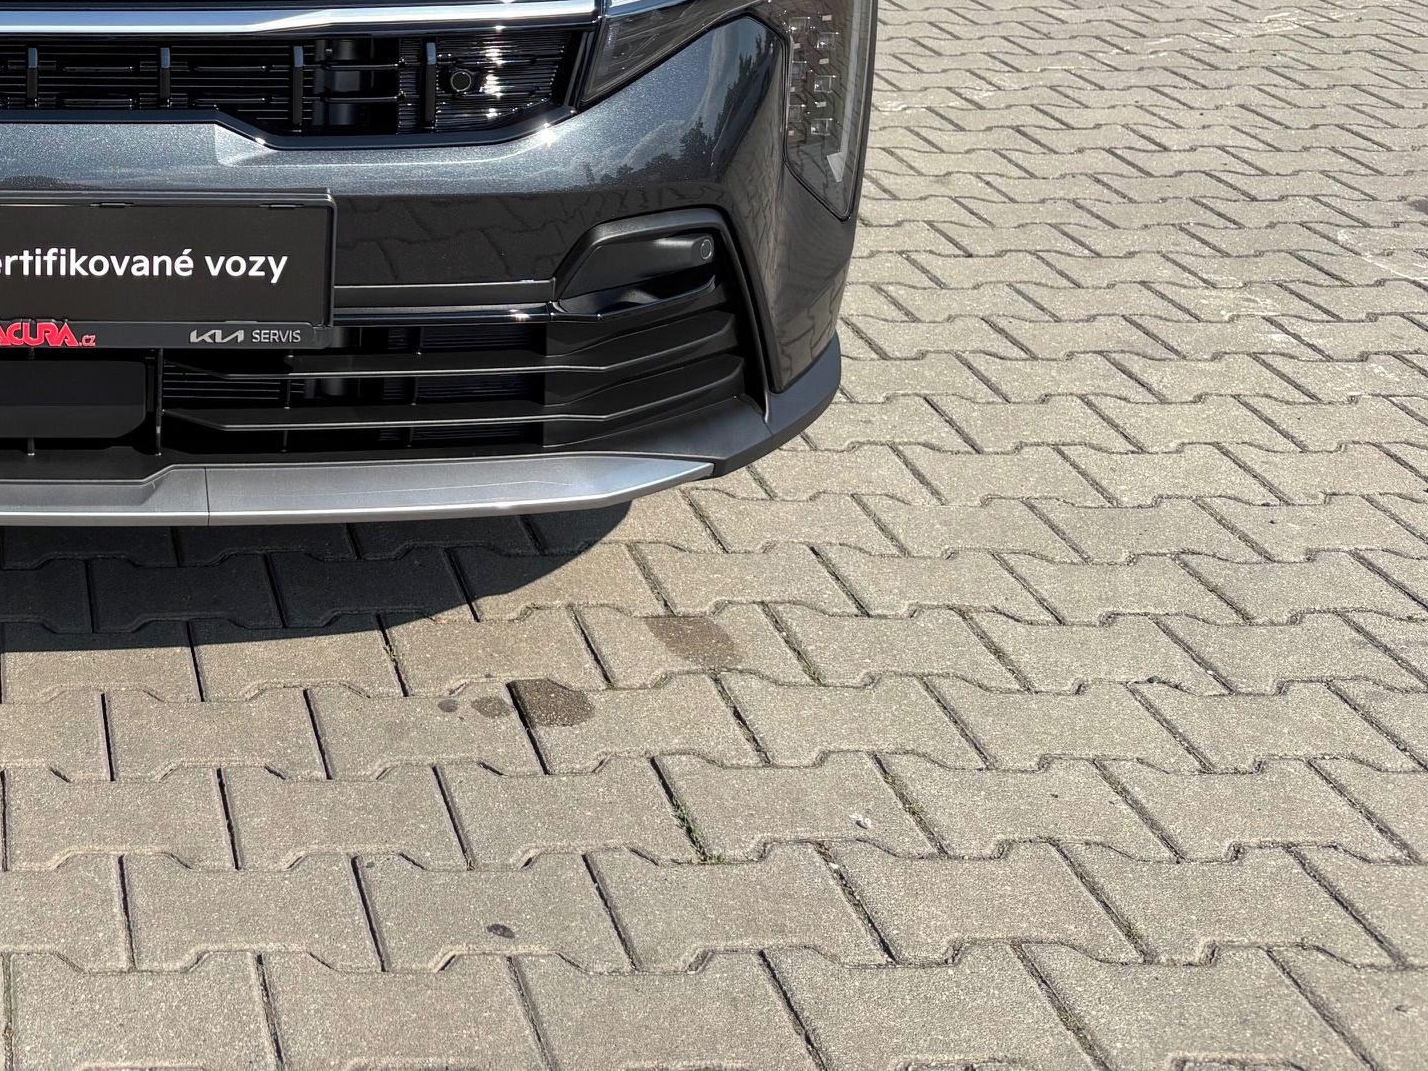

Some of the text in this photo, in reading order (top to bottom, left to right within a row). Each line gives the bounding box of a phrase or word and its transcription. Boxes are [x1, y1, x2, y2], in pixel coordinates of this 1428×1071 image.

[205, 255, 288, 284] vozy
[190, 329, 301, 344] KIA SERVIS
